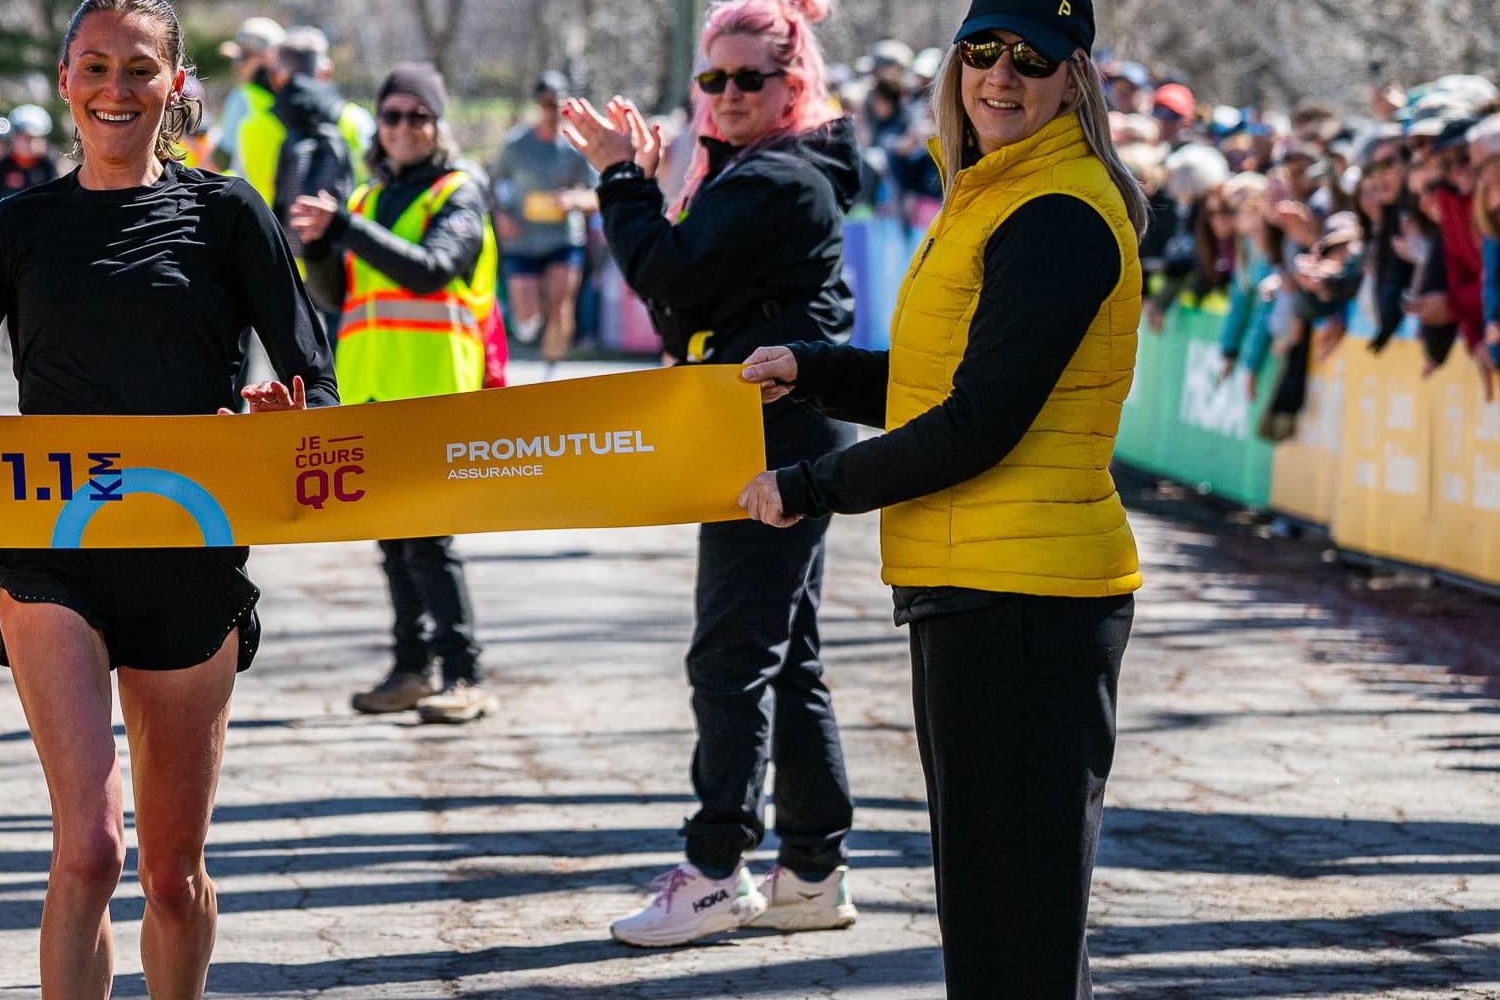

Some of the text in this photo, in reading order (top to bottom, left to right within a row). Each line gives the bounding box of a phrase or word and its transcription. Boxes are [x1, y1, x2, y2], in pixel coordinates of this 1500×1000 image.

[296, 435, 321, 452] JE
[445, 430, 655, 464] PROMUTUEL
[295, 448, 365, 469] COURS
[87, 452, 124, 501] KM
[447, 464, 544, 480] ASSURANCE
[295, 464, 366, 510] QC
[691, 889, 730, 914] HOKA
